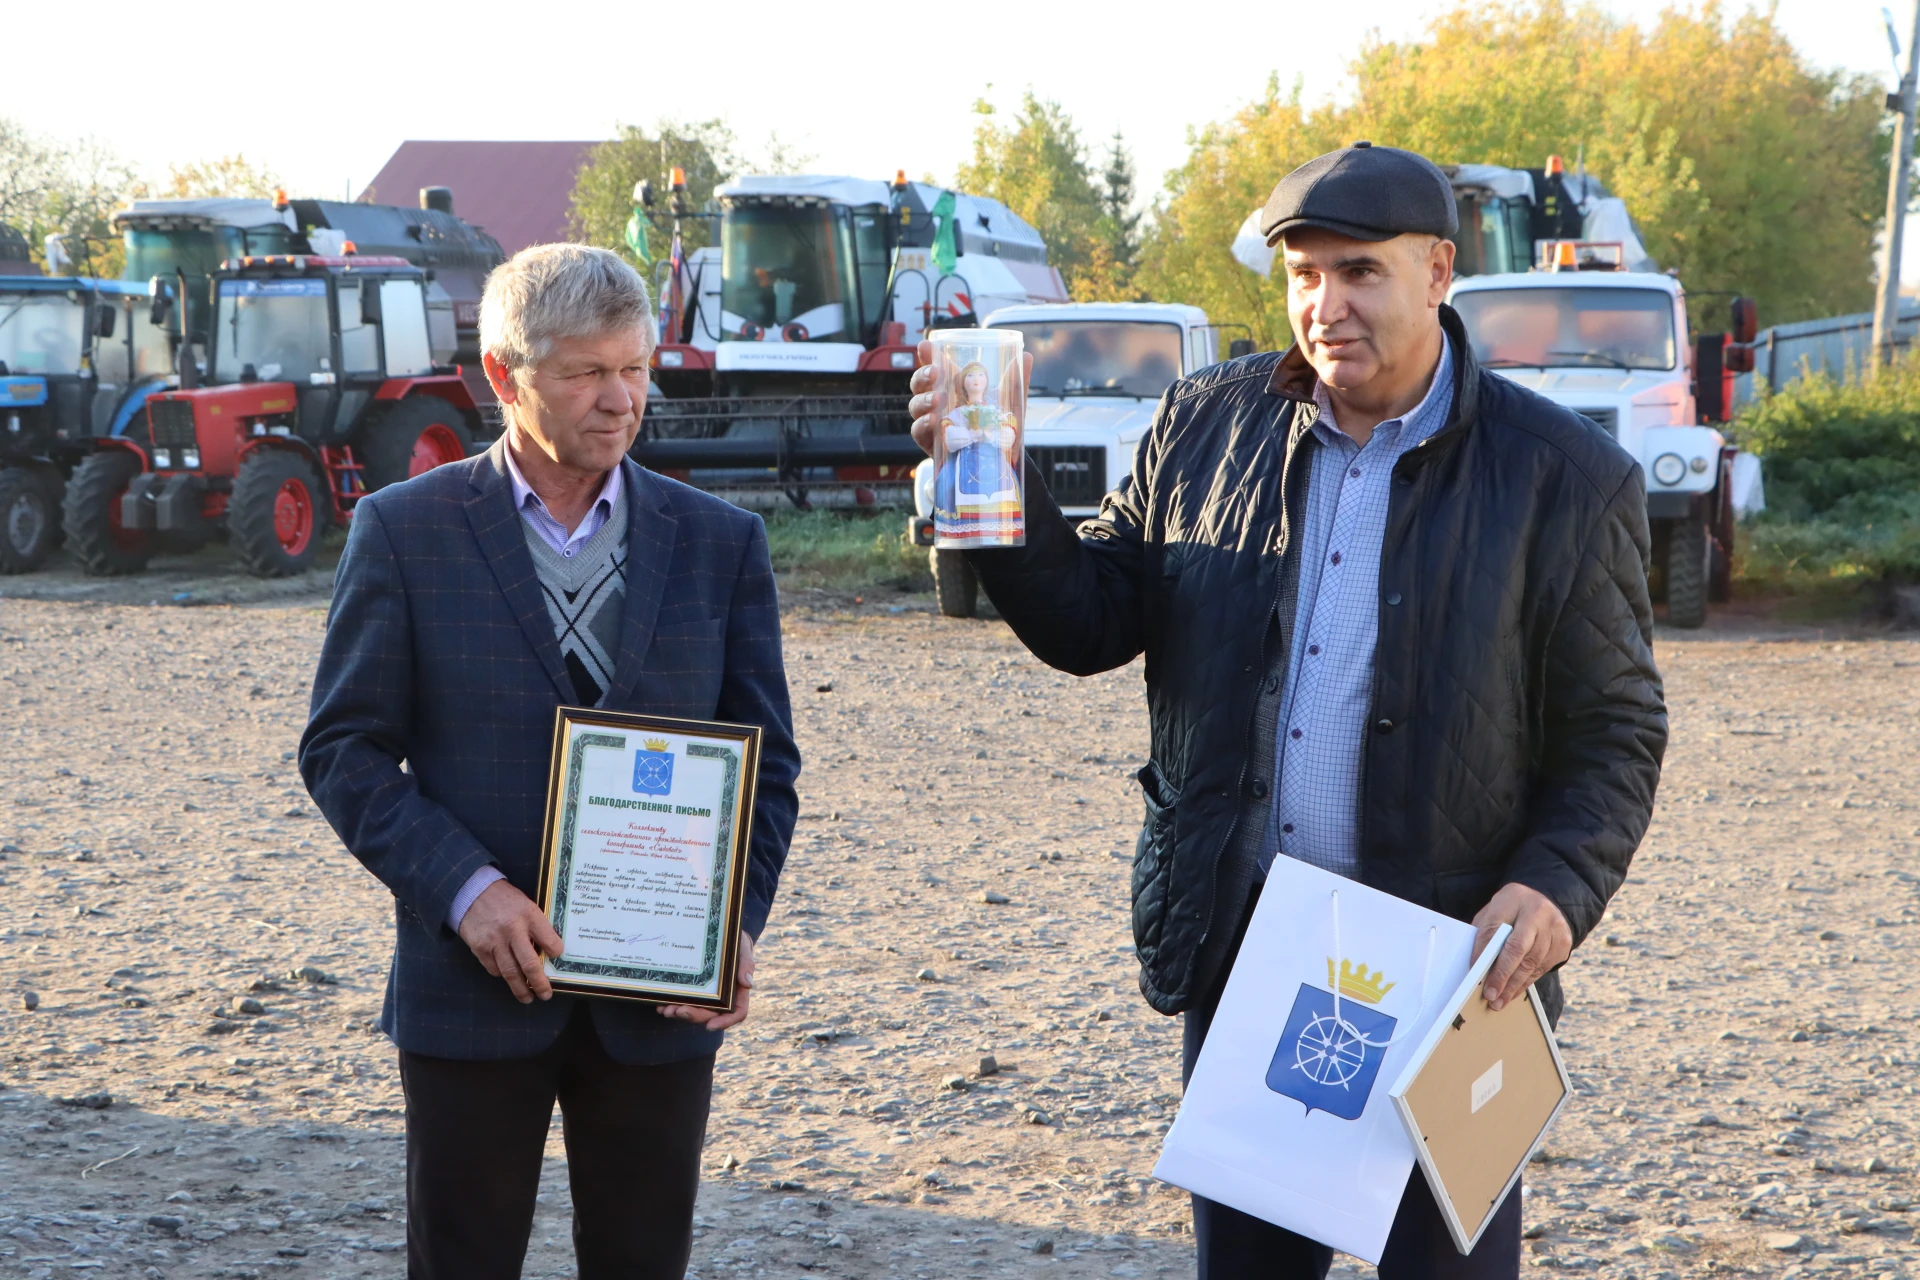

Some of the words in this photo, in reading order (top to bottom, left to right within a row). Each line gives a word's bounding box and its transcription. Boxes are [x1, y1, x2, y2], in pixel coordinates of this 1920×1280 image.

[588, 796, 672, 814] БЛАГОДАРСТВЕННОЕ
[676, 806, 711, 817] ПИСЬМО
[627, 822, 666, 834] Коллективу
[607, 838, 644, 850] кооператива
[649, 842, 682, 853] «Садовод»
